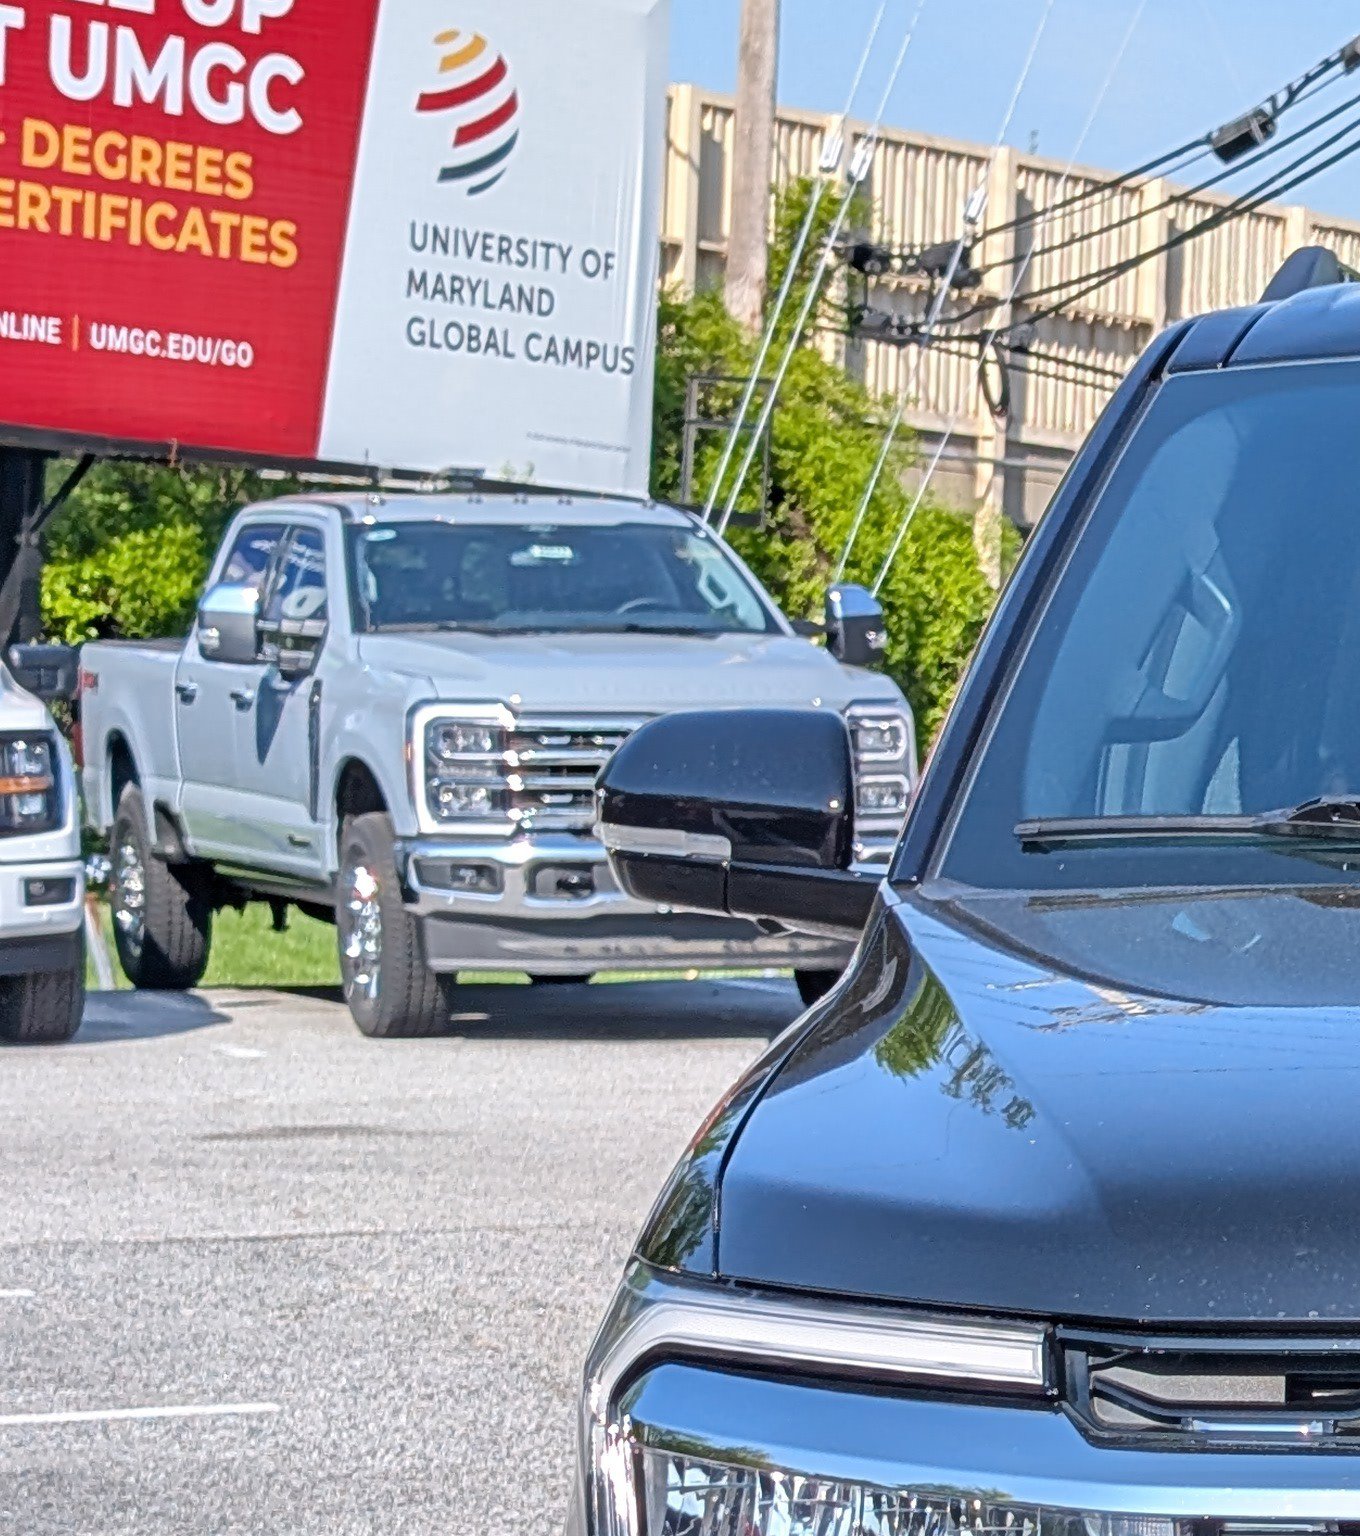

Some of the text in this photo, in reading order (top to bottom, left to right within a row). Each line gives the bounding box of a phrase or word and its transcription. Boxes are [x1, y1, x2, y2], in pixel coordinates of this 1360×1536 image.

[49, 13, 305, 135] UMGC
[21, 117, 254, 200] DEGREES
[409, 220, 615, 280] UNIVERSITY OF
[406, 268, 555, 317] MARYLAND
[90, 322, 254, 368] UMGC.EDU/GO
[406, 316, 636, 375] GLOBAL CAMPUS
